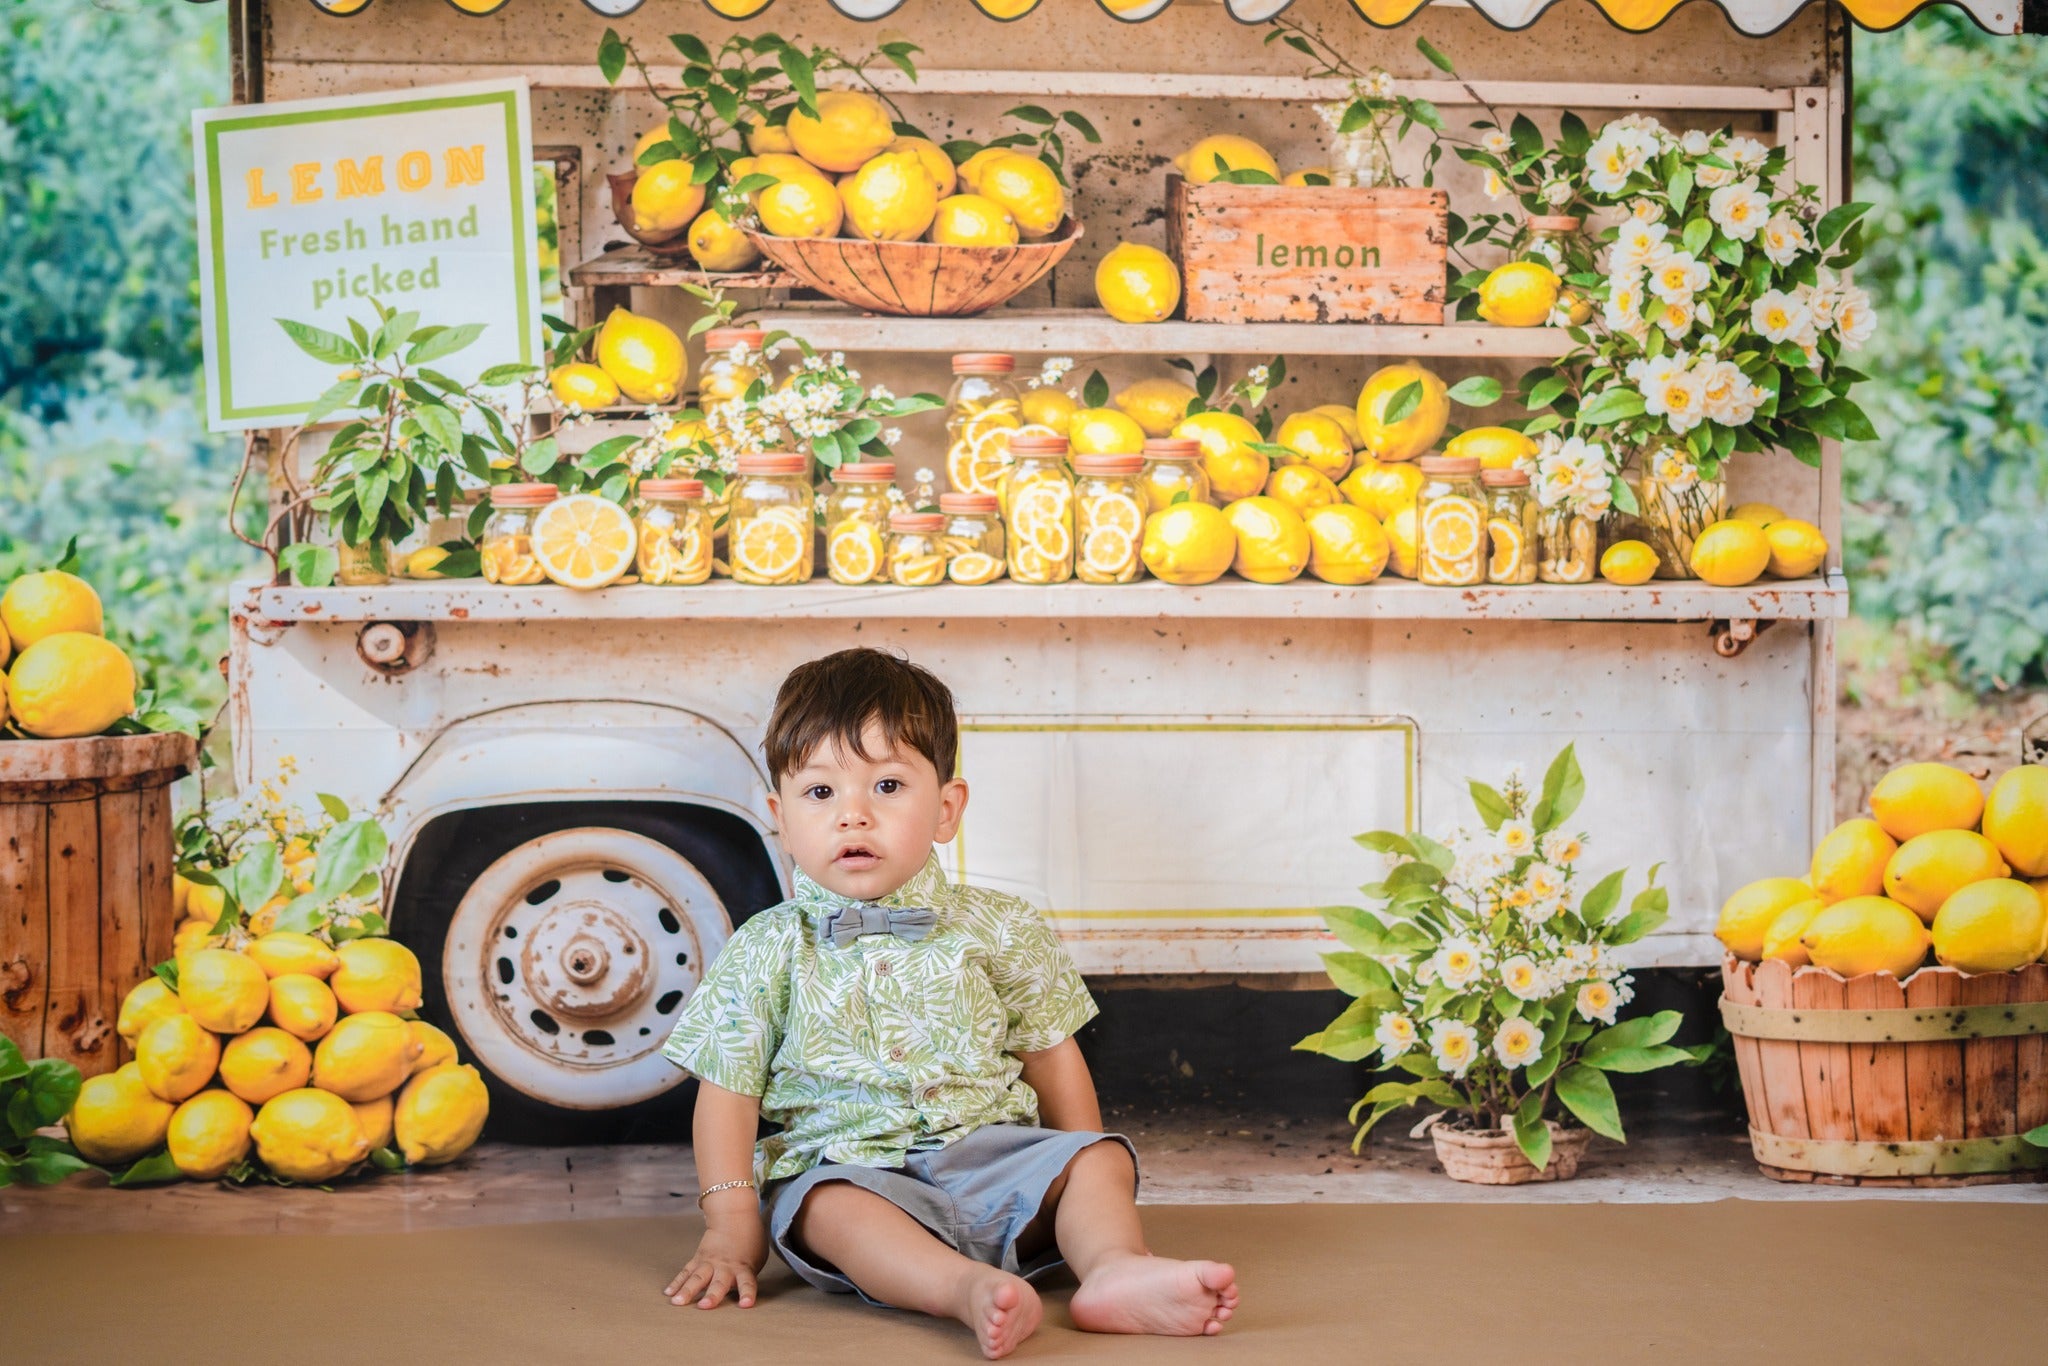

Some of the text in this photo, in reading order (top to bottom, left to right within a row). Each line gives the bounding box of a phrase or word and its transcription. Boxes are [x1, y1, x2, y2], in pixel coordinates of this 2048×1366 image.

[245, 145, 485, 208] LEMON
[260, 205, 478, 259] Fresh hand
[1257, 233, 1380, 268] lemon
[312, 257, 440, 309] picked
